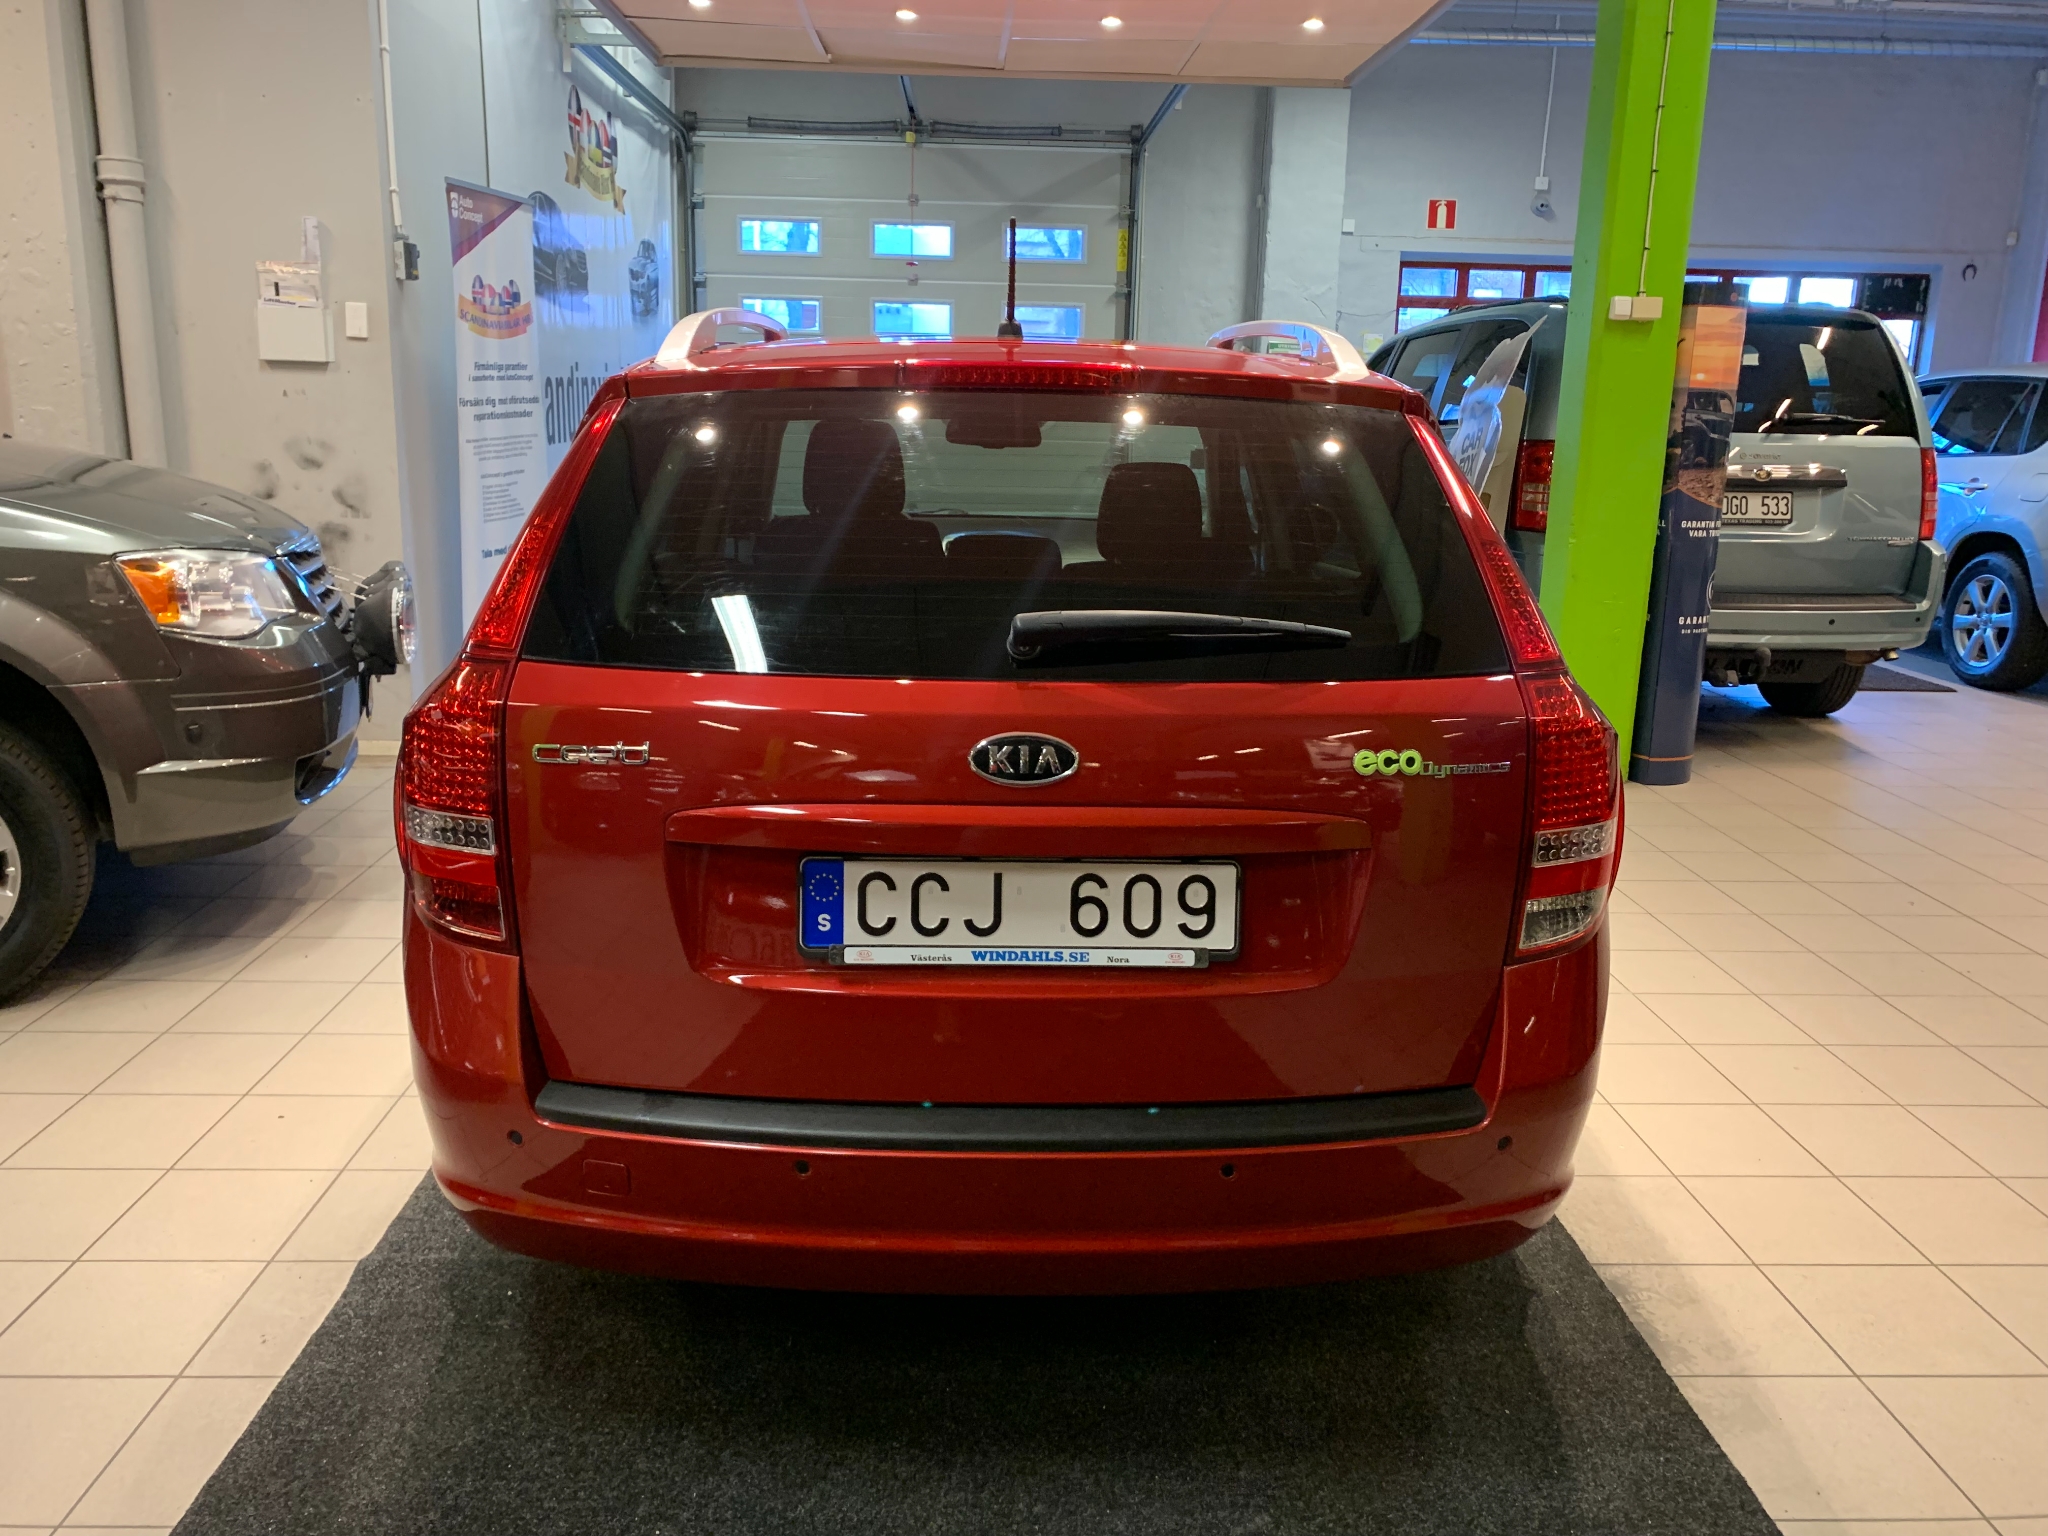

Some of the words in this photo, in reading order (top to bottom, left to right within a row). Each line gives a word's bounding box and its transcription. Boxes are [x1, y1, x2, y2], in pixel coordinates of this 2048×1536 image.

[459, 195, 474, 209] Auto
[459, 207, 484, 224] Concept
[1461, 427, 1484, 455] CAR
[1761, 495, 1790, 516] 533
[1689, 529, 1707, 537] VARA
[987, 744, 1062, 774] KIA
[857, 871, 1003, 937] CCJ
[1070, 872, 1217, 938] 609
[817, 913, 831, 932] S
[910, 952, 952, 962] Västerås
[971, 950, 1090, 963] WINDAHLS.SE
[1106, 956, 1130, 964] Nora
